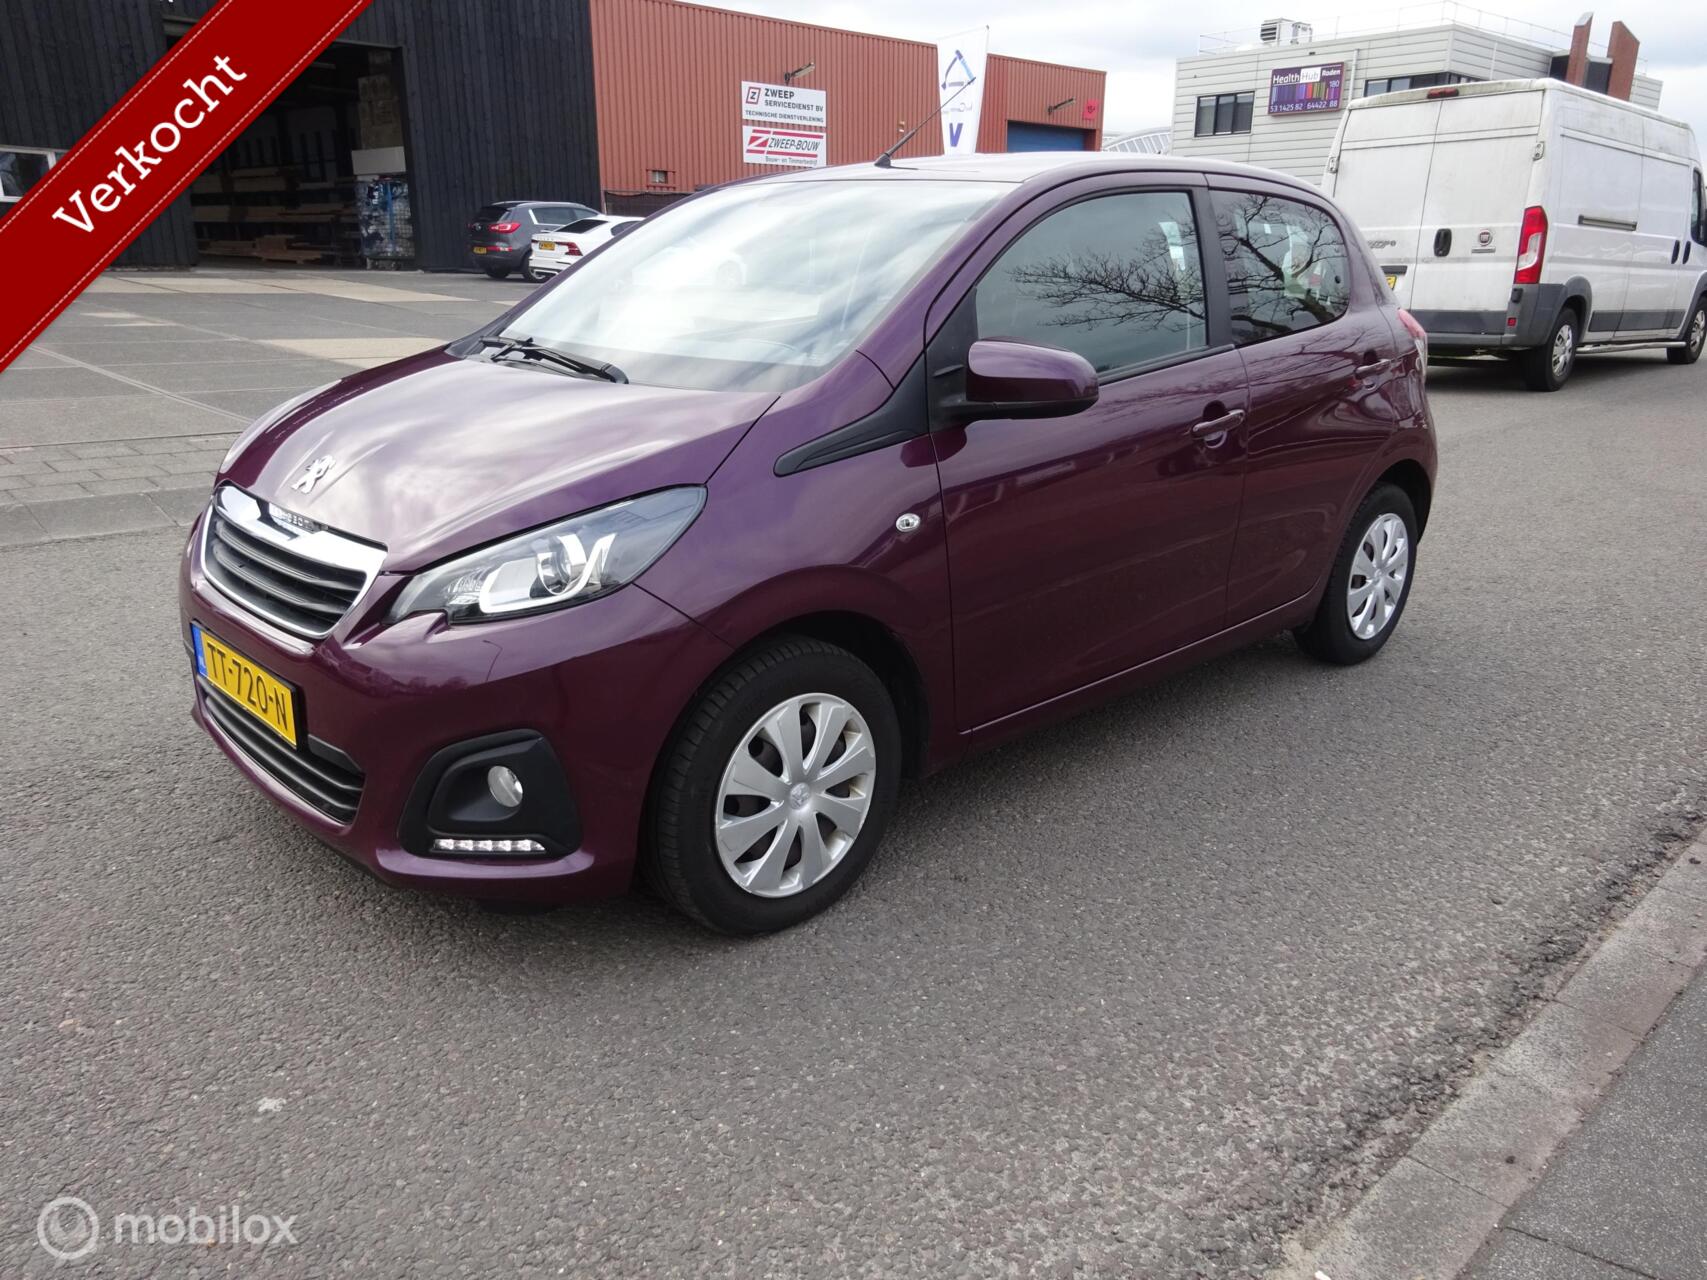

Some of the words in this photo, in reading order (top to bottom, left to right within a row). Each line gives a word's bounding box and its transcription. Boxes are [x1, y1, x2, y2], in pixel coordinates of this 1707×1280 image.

[1273, 73, 1299, 84] Health
[1301, 71, 1319, 81] Hub
[1322, 69, 1340, 77] Roden
[764, 88, 795, 100] ZWEEP
[765, 100, 814, 111] SERVICEDIENST
[745, 110, 777, 119] TECHNISCHE
[779, 113, 824, 123] DIENSTVERLENING
[768, 137, 820, 151] ZWEEP-BOUW
[207, 642, 288, 731] TT-720-N
